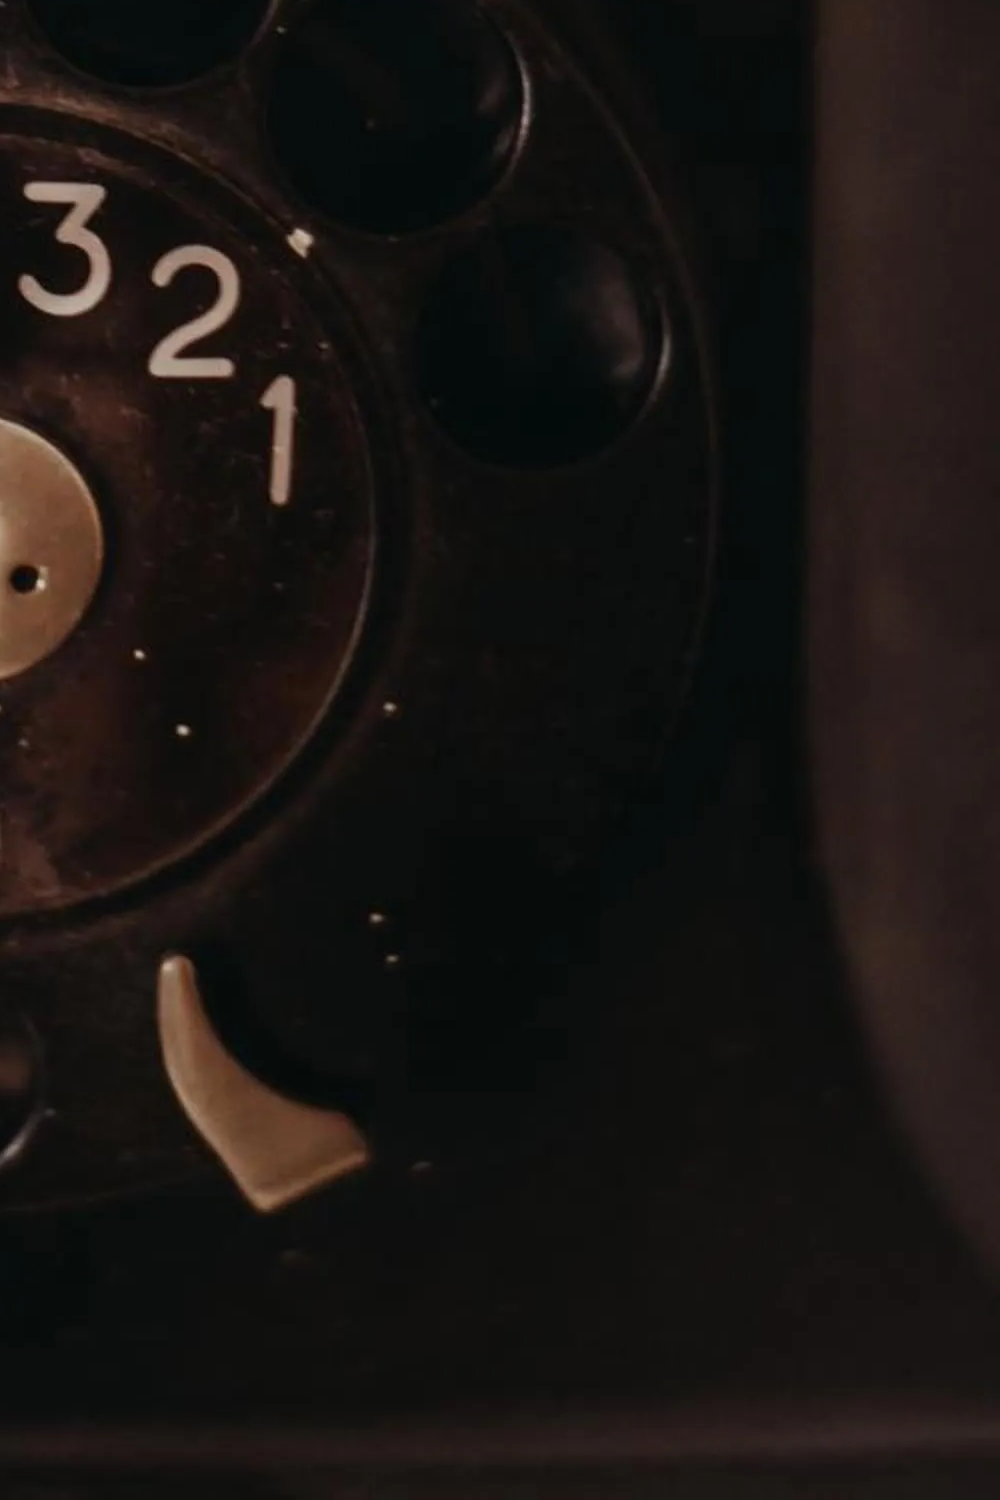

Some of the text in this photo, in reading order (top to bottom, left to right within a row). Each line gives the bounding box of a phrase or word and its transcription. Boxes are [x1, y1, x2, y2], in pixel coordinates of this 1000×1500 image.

[17, 181, 112, 317] 3
[147, 244, 241, 378] 2
[259, 375, 298, 505] 1
